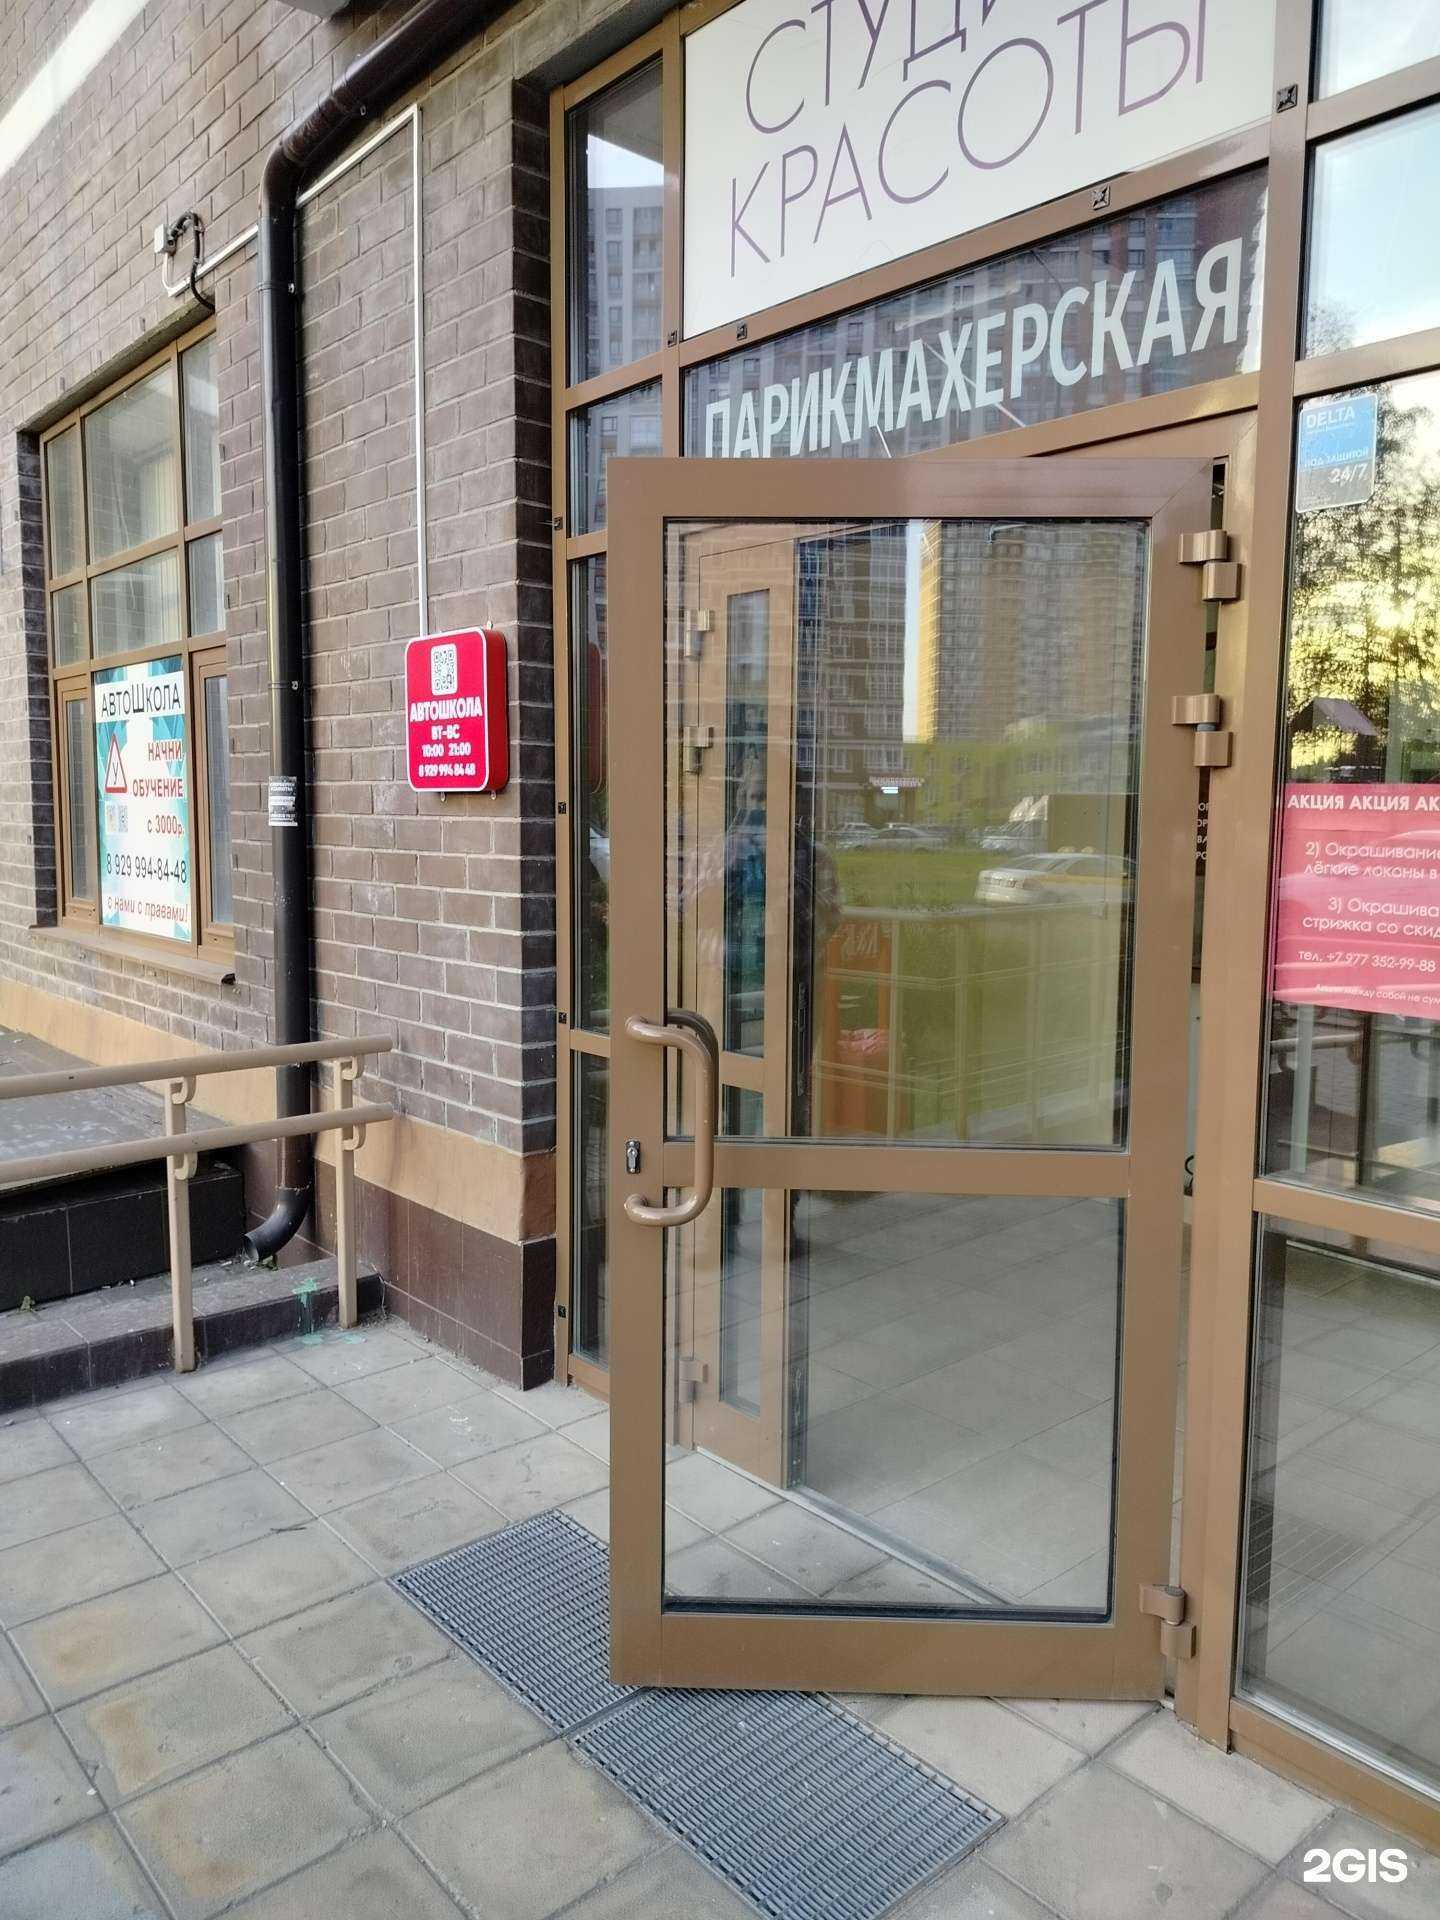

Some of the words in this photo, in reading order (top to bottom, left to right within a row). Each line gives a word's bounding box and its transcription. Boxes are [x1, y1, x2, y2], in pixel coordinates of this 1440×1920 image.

[745, 0, 996, 134] СТУД
[731, 0, 1206, 277] КРАСОТЫ
[705, 238, 1243, 458] ПАРИКМАХЕРСКАЯ
[1306, 406, 1355, 428] DELTA
[1328, 463, 1369, 484] 24/7
[410, 696, 483, 722] АВТОШКОЛА
[431, 724, 460, 740] ВТ-ВС
[148, 741, 183, 761] НАЧНИ
[422, 743, 444, 757] 10:00
[448, 742, 471, 756] 21:00
[425, 764, 438, 776] 929
[132, 778, 183, 798] ОБУЧЕНИЕ
[1287, 795, 1344, 811] АКЦИЯ
[1349, 795, 1409, 812] АКЦИЯ
[1305, 841, 1320, 859] 2)
[107, 853, 113, 875] 8
[115, 854, 132, 877] 929
[135, 856, 187, 884] 994-84-48
[1304, 860, 1359, 876] лёгкие
[1363, 864, 1425, 880] локоны
[1429, 869, 1438, 880] в
[1327, 897, 1342, 914] 3)
[1347, 897, 1440, 917] Окрашива
[1302, 917, 1372, 932] стрижка
[1376, 922, 1399, 934] со
[1345, 953, 1369, 966] 977
[1371, 955, 1437, 973] 352-99-88
[1376, 990, 1406, 1000] собой
